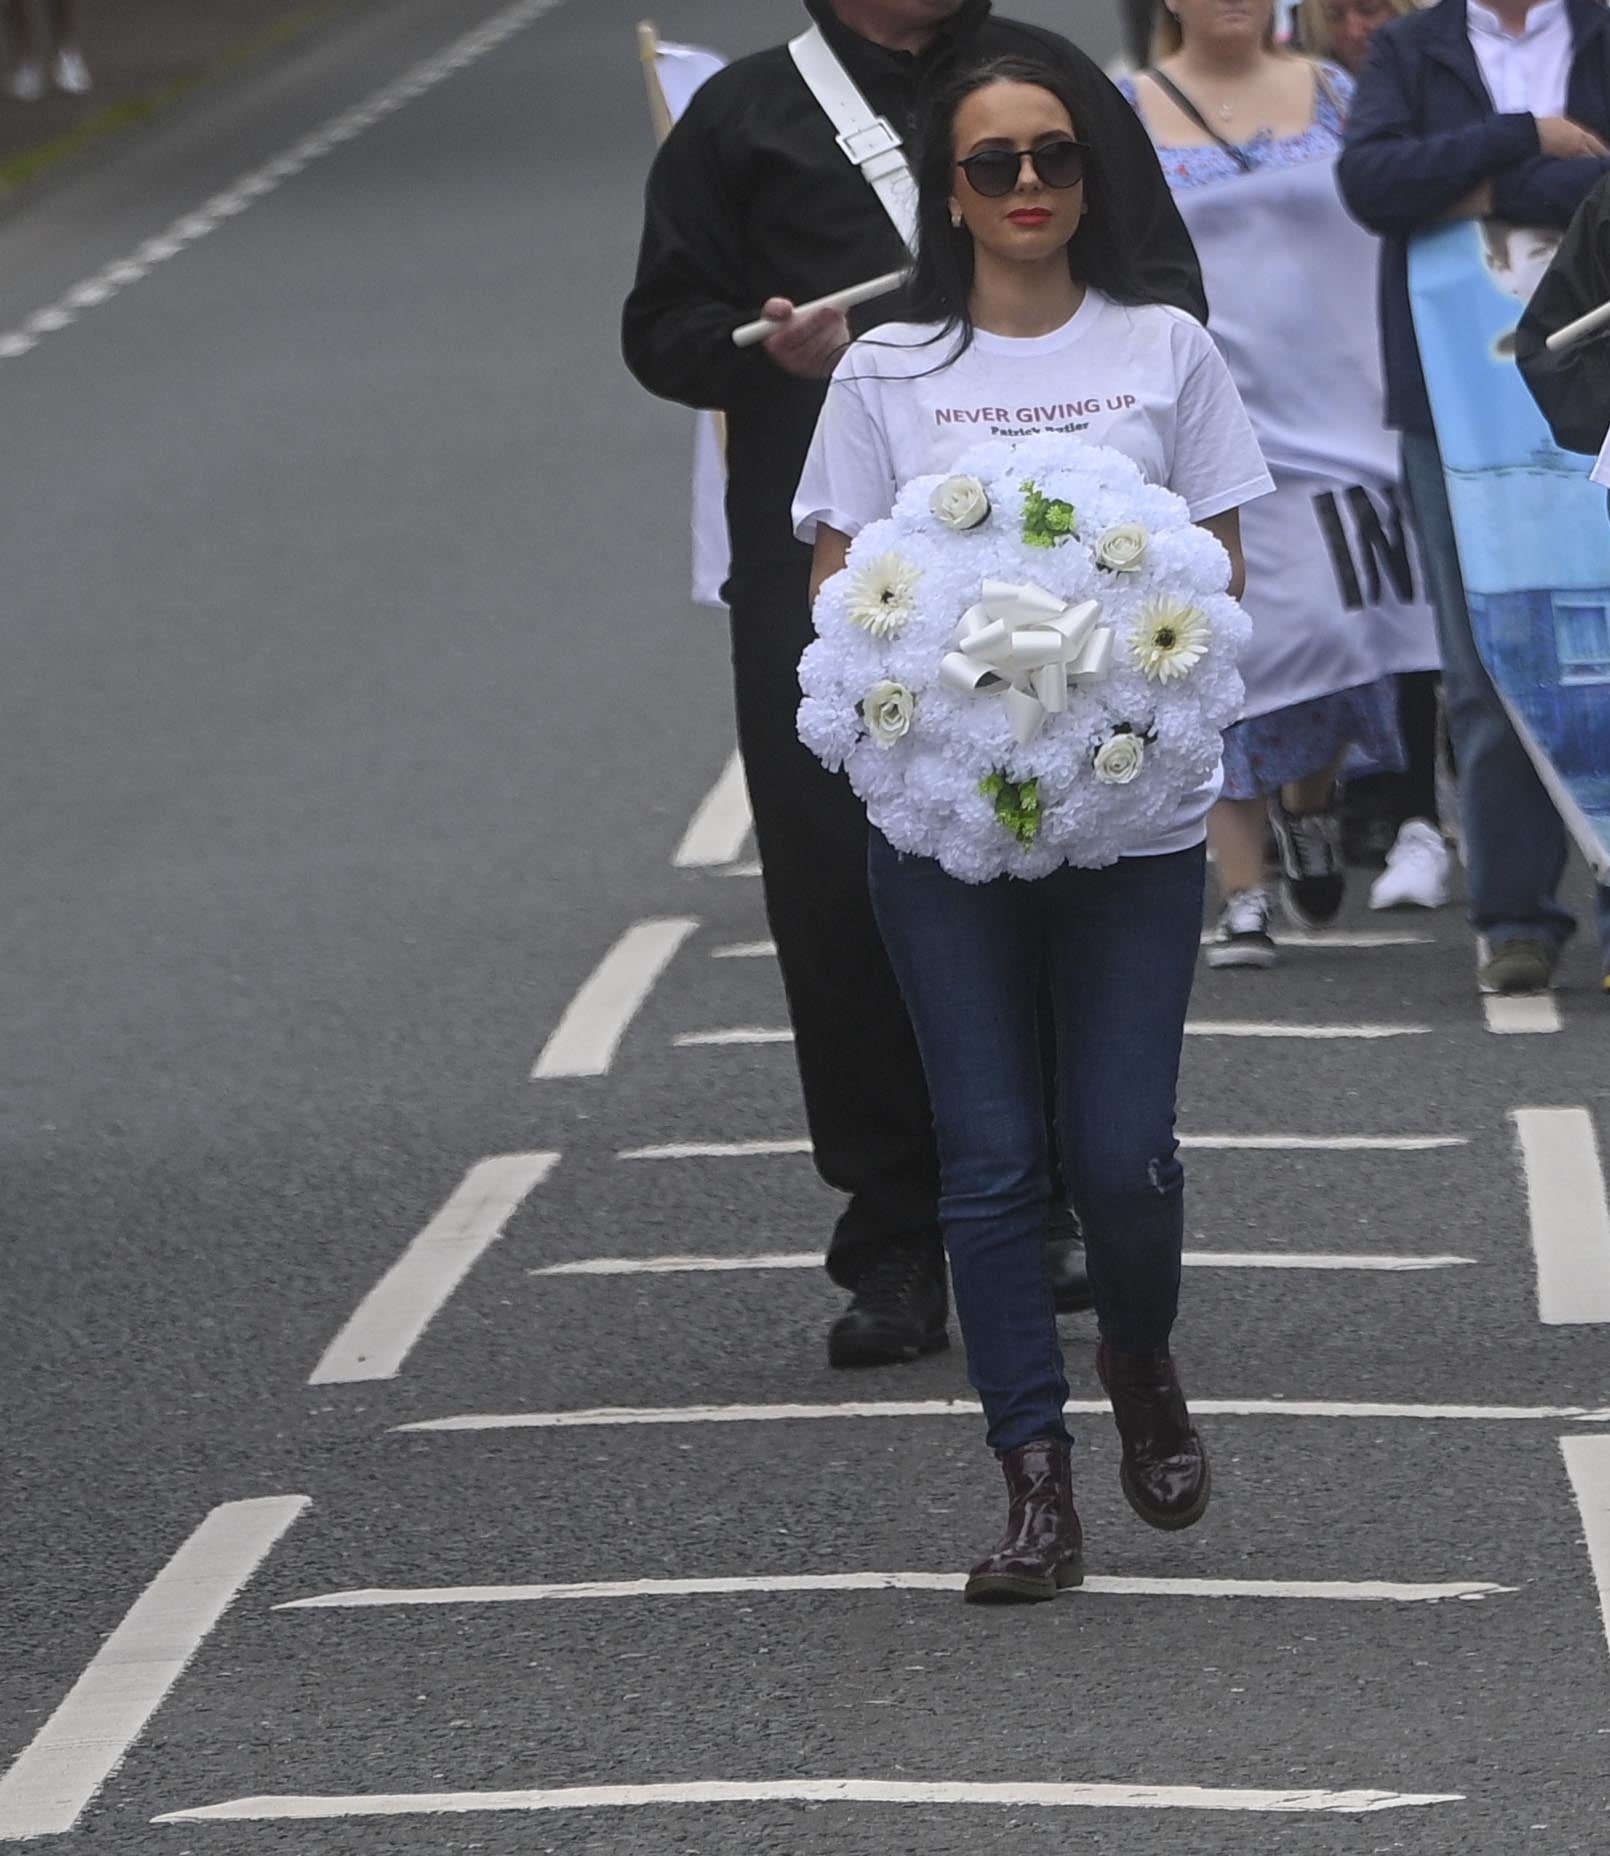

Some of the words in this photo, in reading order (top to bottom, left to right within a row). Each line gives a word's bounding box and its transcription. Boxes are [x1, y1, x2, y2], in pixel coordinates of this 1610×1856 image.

[935, 407, 1010, 426] NEVER
[1015, 398, 1101, 423] GIVING
[1106, 394, 1136, 411] UP
